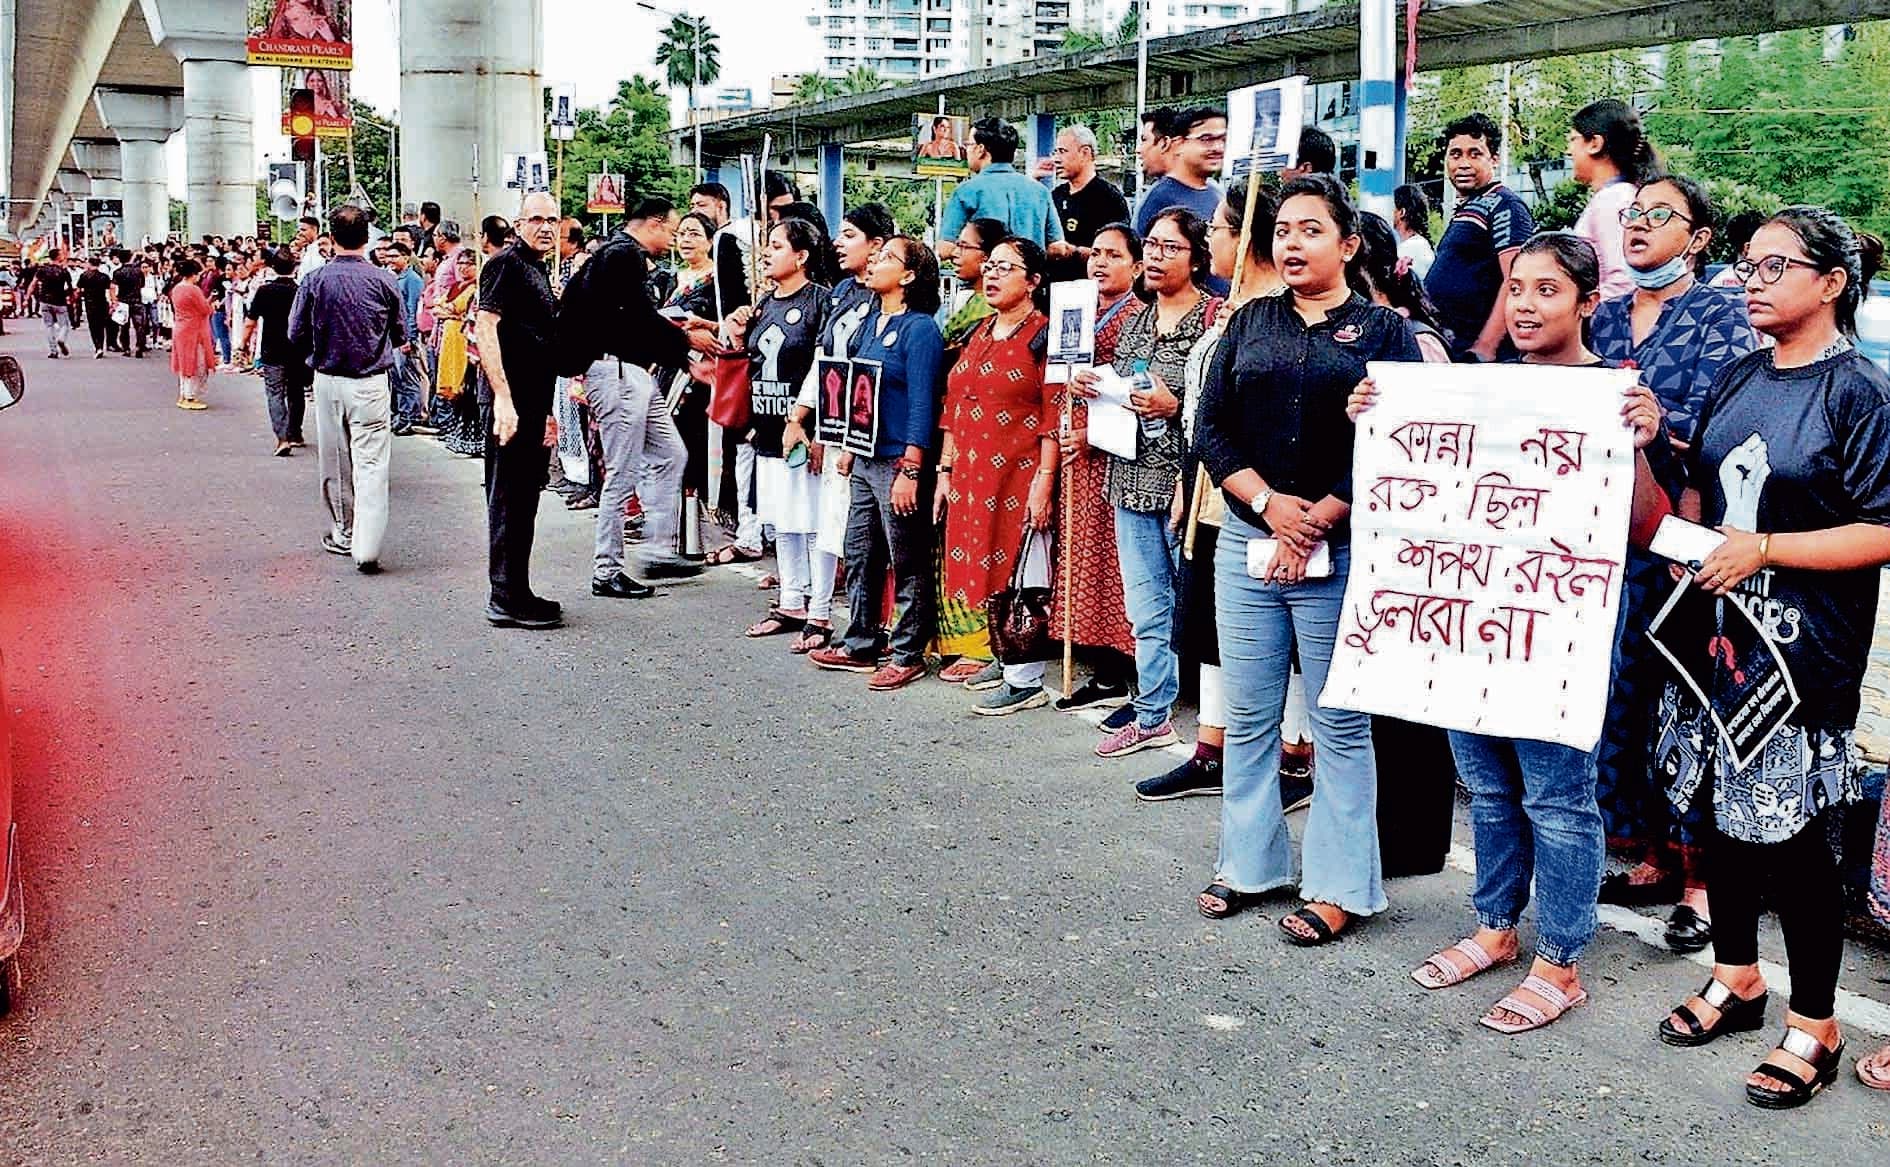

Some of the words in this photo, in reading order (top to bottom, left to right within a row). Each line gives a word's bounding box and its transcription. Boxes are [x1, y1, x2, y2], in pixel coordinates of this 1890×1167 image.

[259, 41, 311, 54] CHANDRANI
[312, 44, 344, 56] PEARLS
[762, 382, 792, 396] WANT
[1390, 422, 1476, 468] কান্না
[1520, 428, 1588, 475] নয়
[1370, 476, 1437, 512] রক্ত
[1468, 471, 1551, 530] ছিল
[1398, 538, 1503, 589] শপথ
[1515, 537, 1620, 608] রইল
[1345, 590, 1475, 655] ভুলবো
[1478, 606, 1551, 662] না
